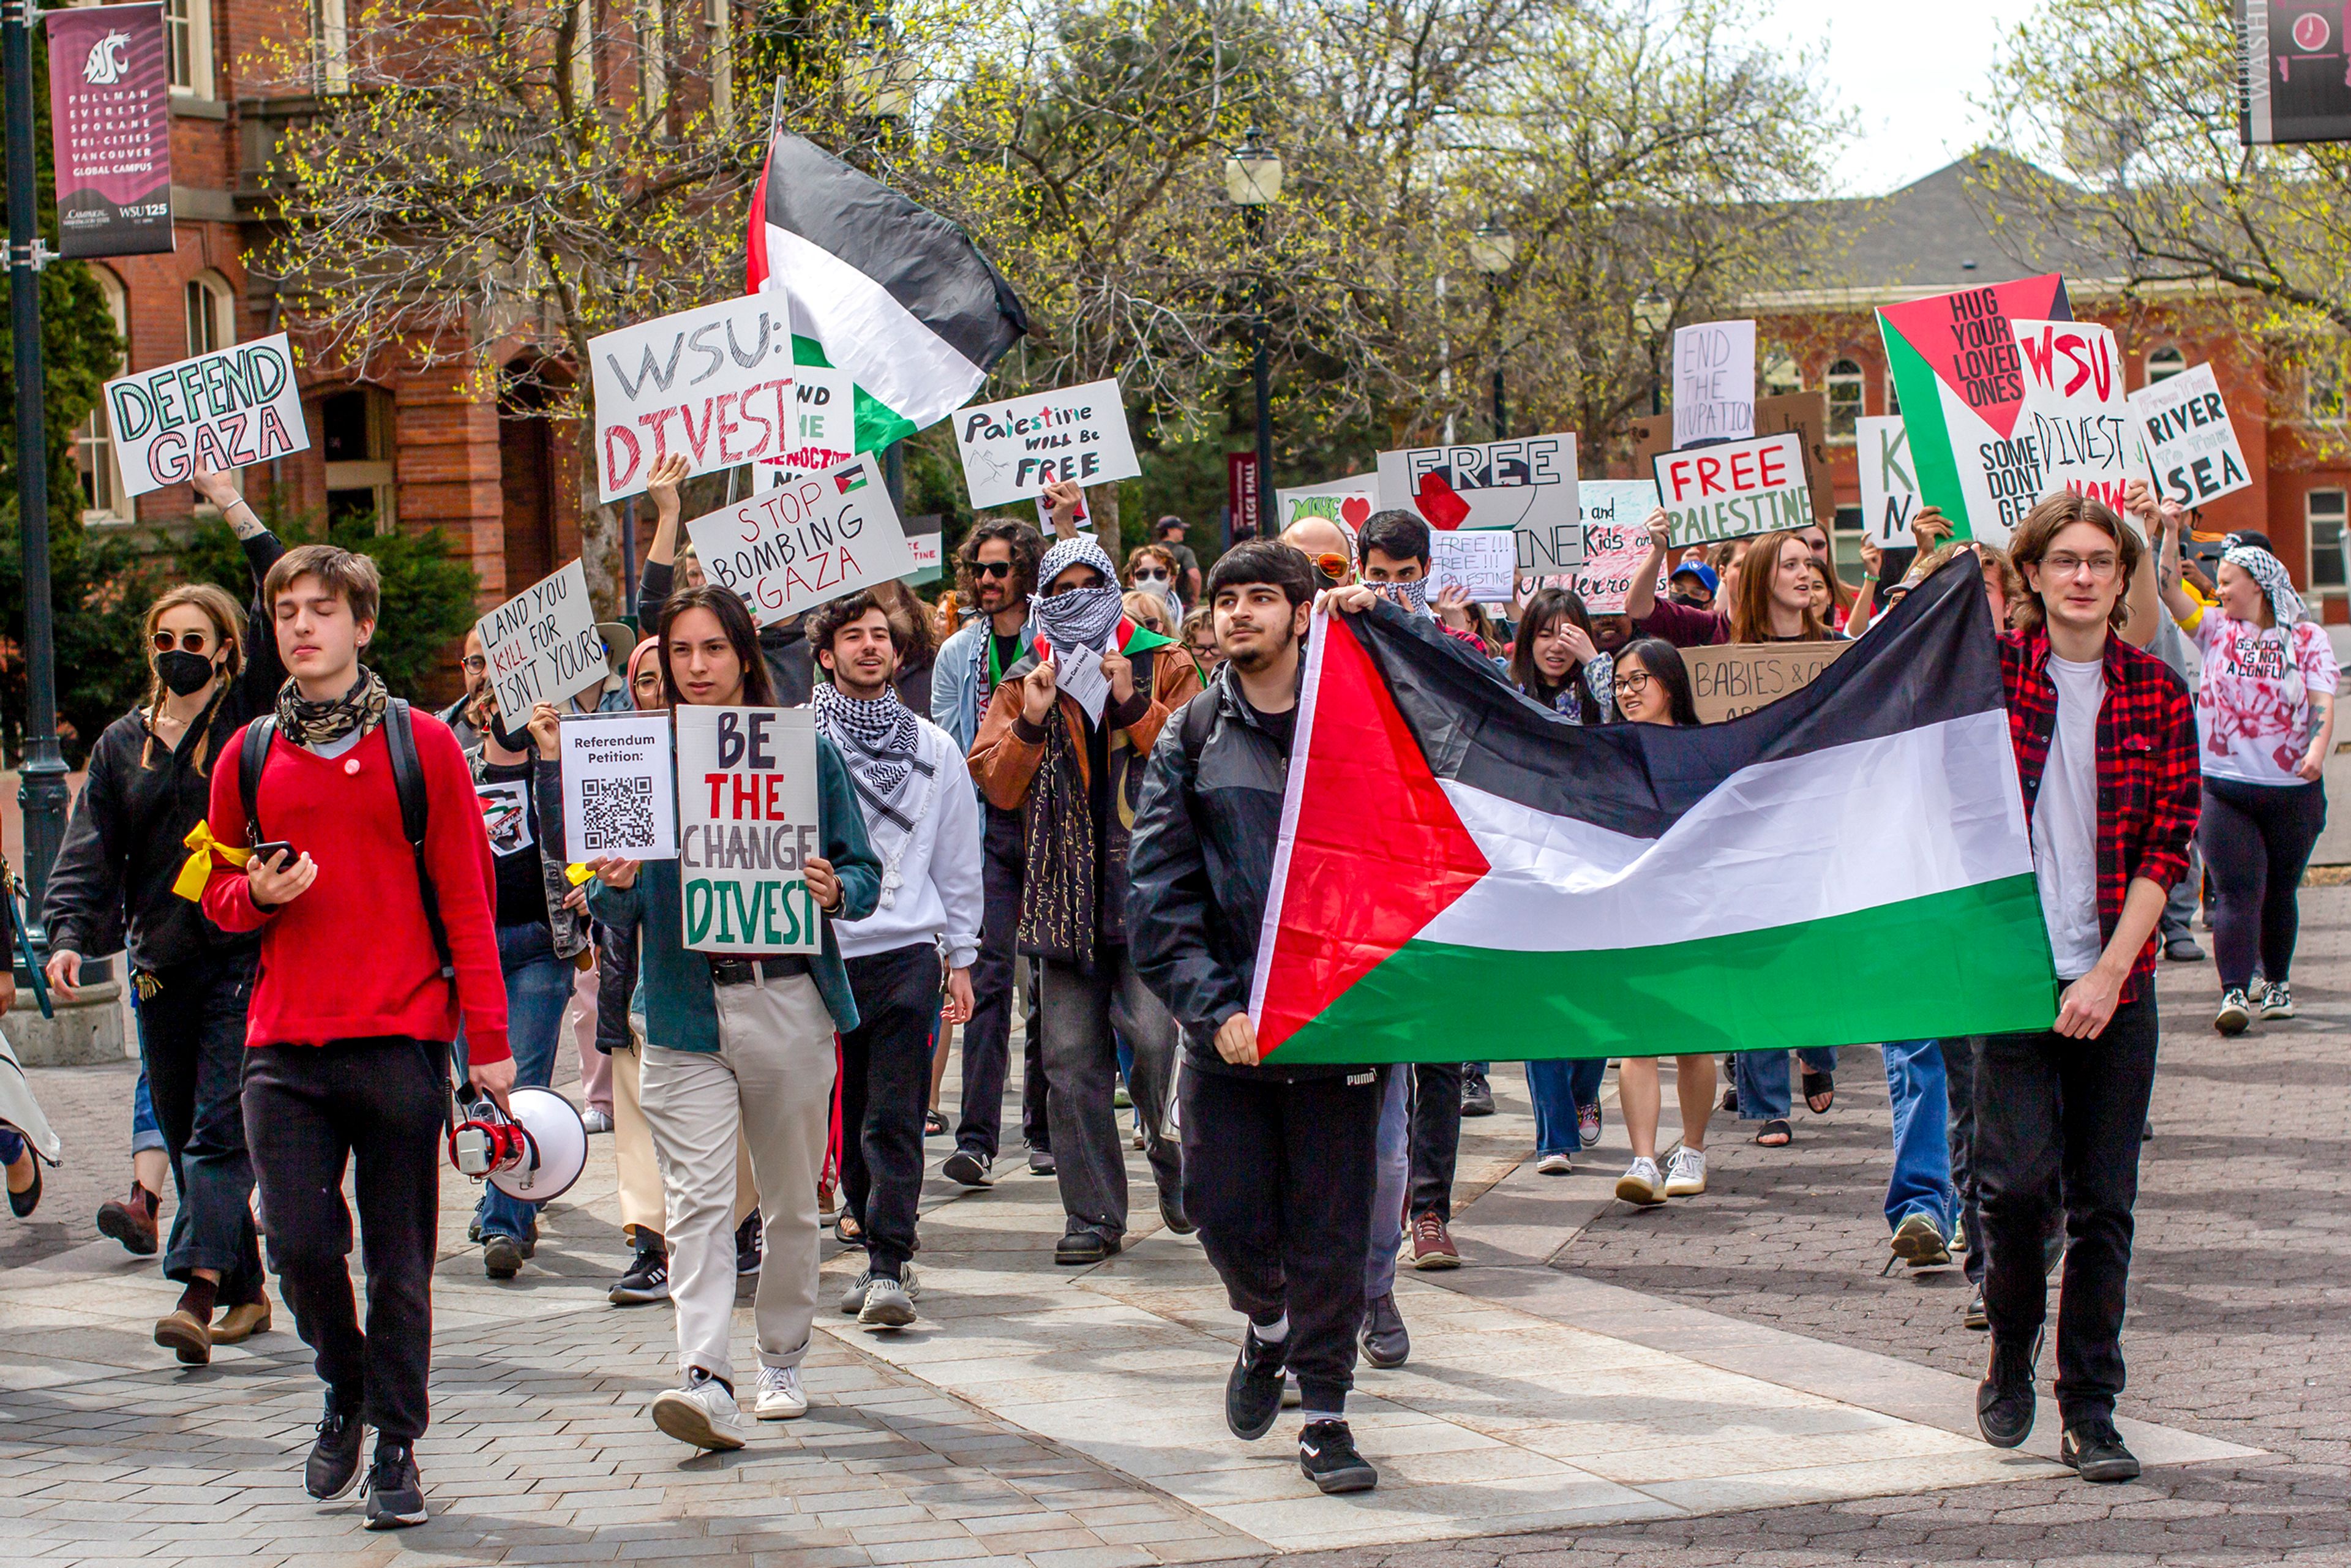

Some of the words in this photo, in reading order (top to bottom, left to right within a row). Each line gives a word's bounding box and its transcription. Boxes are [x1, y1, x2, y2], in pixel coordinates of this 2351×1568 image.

[2235, 16, 2251, 113] CELEBRATE
[69, 89, 148, 104] PULLMAN
[70, 104, 148, 119] EVERETT
[70, 119, 149, 133] SPOKANE
[71, 133, 150, 148] TRI-CITIES
[72, 148, 151, 162] VANCOUVER
[73, 165, 110, 176] GLOBAL
[113, 162, 152, 173] CAMPUS
[1948, 288, 1998, 322] HUG
[1684, 329, 1730, 373] END
[1950, 315, 2011, 351] YOUR
[607, 312, 782, 402] WSU:
[1952, 343, 2021, 382] LOVED
[2020, 325, 2111, 403] WSU
[111, 346, 287, 442] DEFEND
[797, 384, 830, 405] ND
[1684, 370, 1728, 403] THE
[1965, 372, 2022, 408] ONES
[604, 377, 793, 492] DIVEST
[965, 405, 1092, 443] Palestine
[2146, 392, 2225, 447] RIVER
[148, 405, 293, 486] GAZA
[1025, 434, 1073, 451] WILL
[1979, 435, 2039, 471] SOME
[2034, 411, 2124, 474] DIVEST
[1015, 452, 1100, 487] FREE
[1245, 462, 1256, 494] HALL
[1407, 439, 1561, 497] FREE
[1670, 445, 1787, 501] FREE
[1986, 463, 2044, 500] DONT
[2168, 449, 2244, 506] SEA
[738, 482, 822, 543] STOP
[1592, 497, 1615, 521] and
[1668, 486, 1813, 546] PALESTINE
[1997, 493, 2039, 528] GET
[713, 504, 863, 588] BOMBING
[913, 550, 936, 561] TINE
[1513, 524, 1581, 569] INE
[1583, 525, 1624, 557] Kids
[757, 546, 862, 610] GAZA
[1441, 570, 1511, 590] PALESTINE
[481, 597, 528, 649] LAND
[533, 575, 567, 613] YOU
[492, 639, 528, 678] KILL
[529, 613, 561, 653] FOR
[2243, 652, 2255, 663] IS
[497, 659, 542, 718] ISN'T
[546, 623, 602, 686] YOURS
[1063, 675, 1073, 687] How
[1071, 666, 1079, 676] Can
[1080, 648, 1090, 664] Help?
[1695, 659, 1784, 697] BABIES
[1791, 664, 1804, 683] &
[2226, 660, 2235, 675] A
[574, 734, 655, 749] Referendum
[588, 751, 644, 764] Petition:
[718, 712, 776, 770] BE
[704, 773, 784, 821] THE
[683, 823, 817, 871] CHANGE
[685, 877, 815, 946] DIVEST
[1347, 1071, 1375, 1086] PUMA
